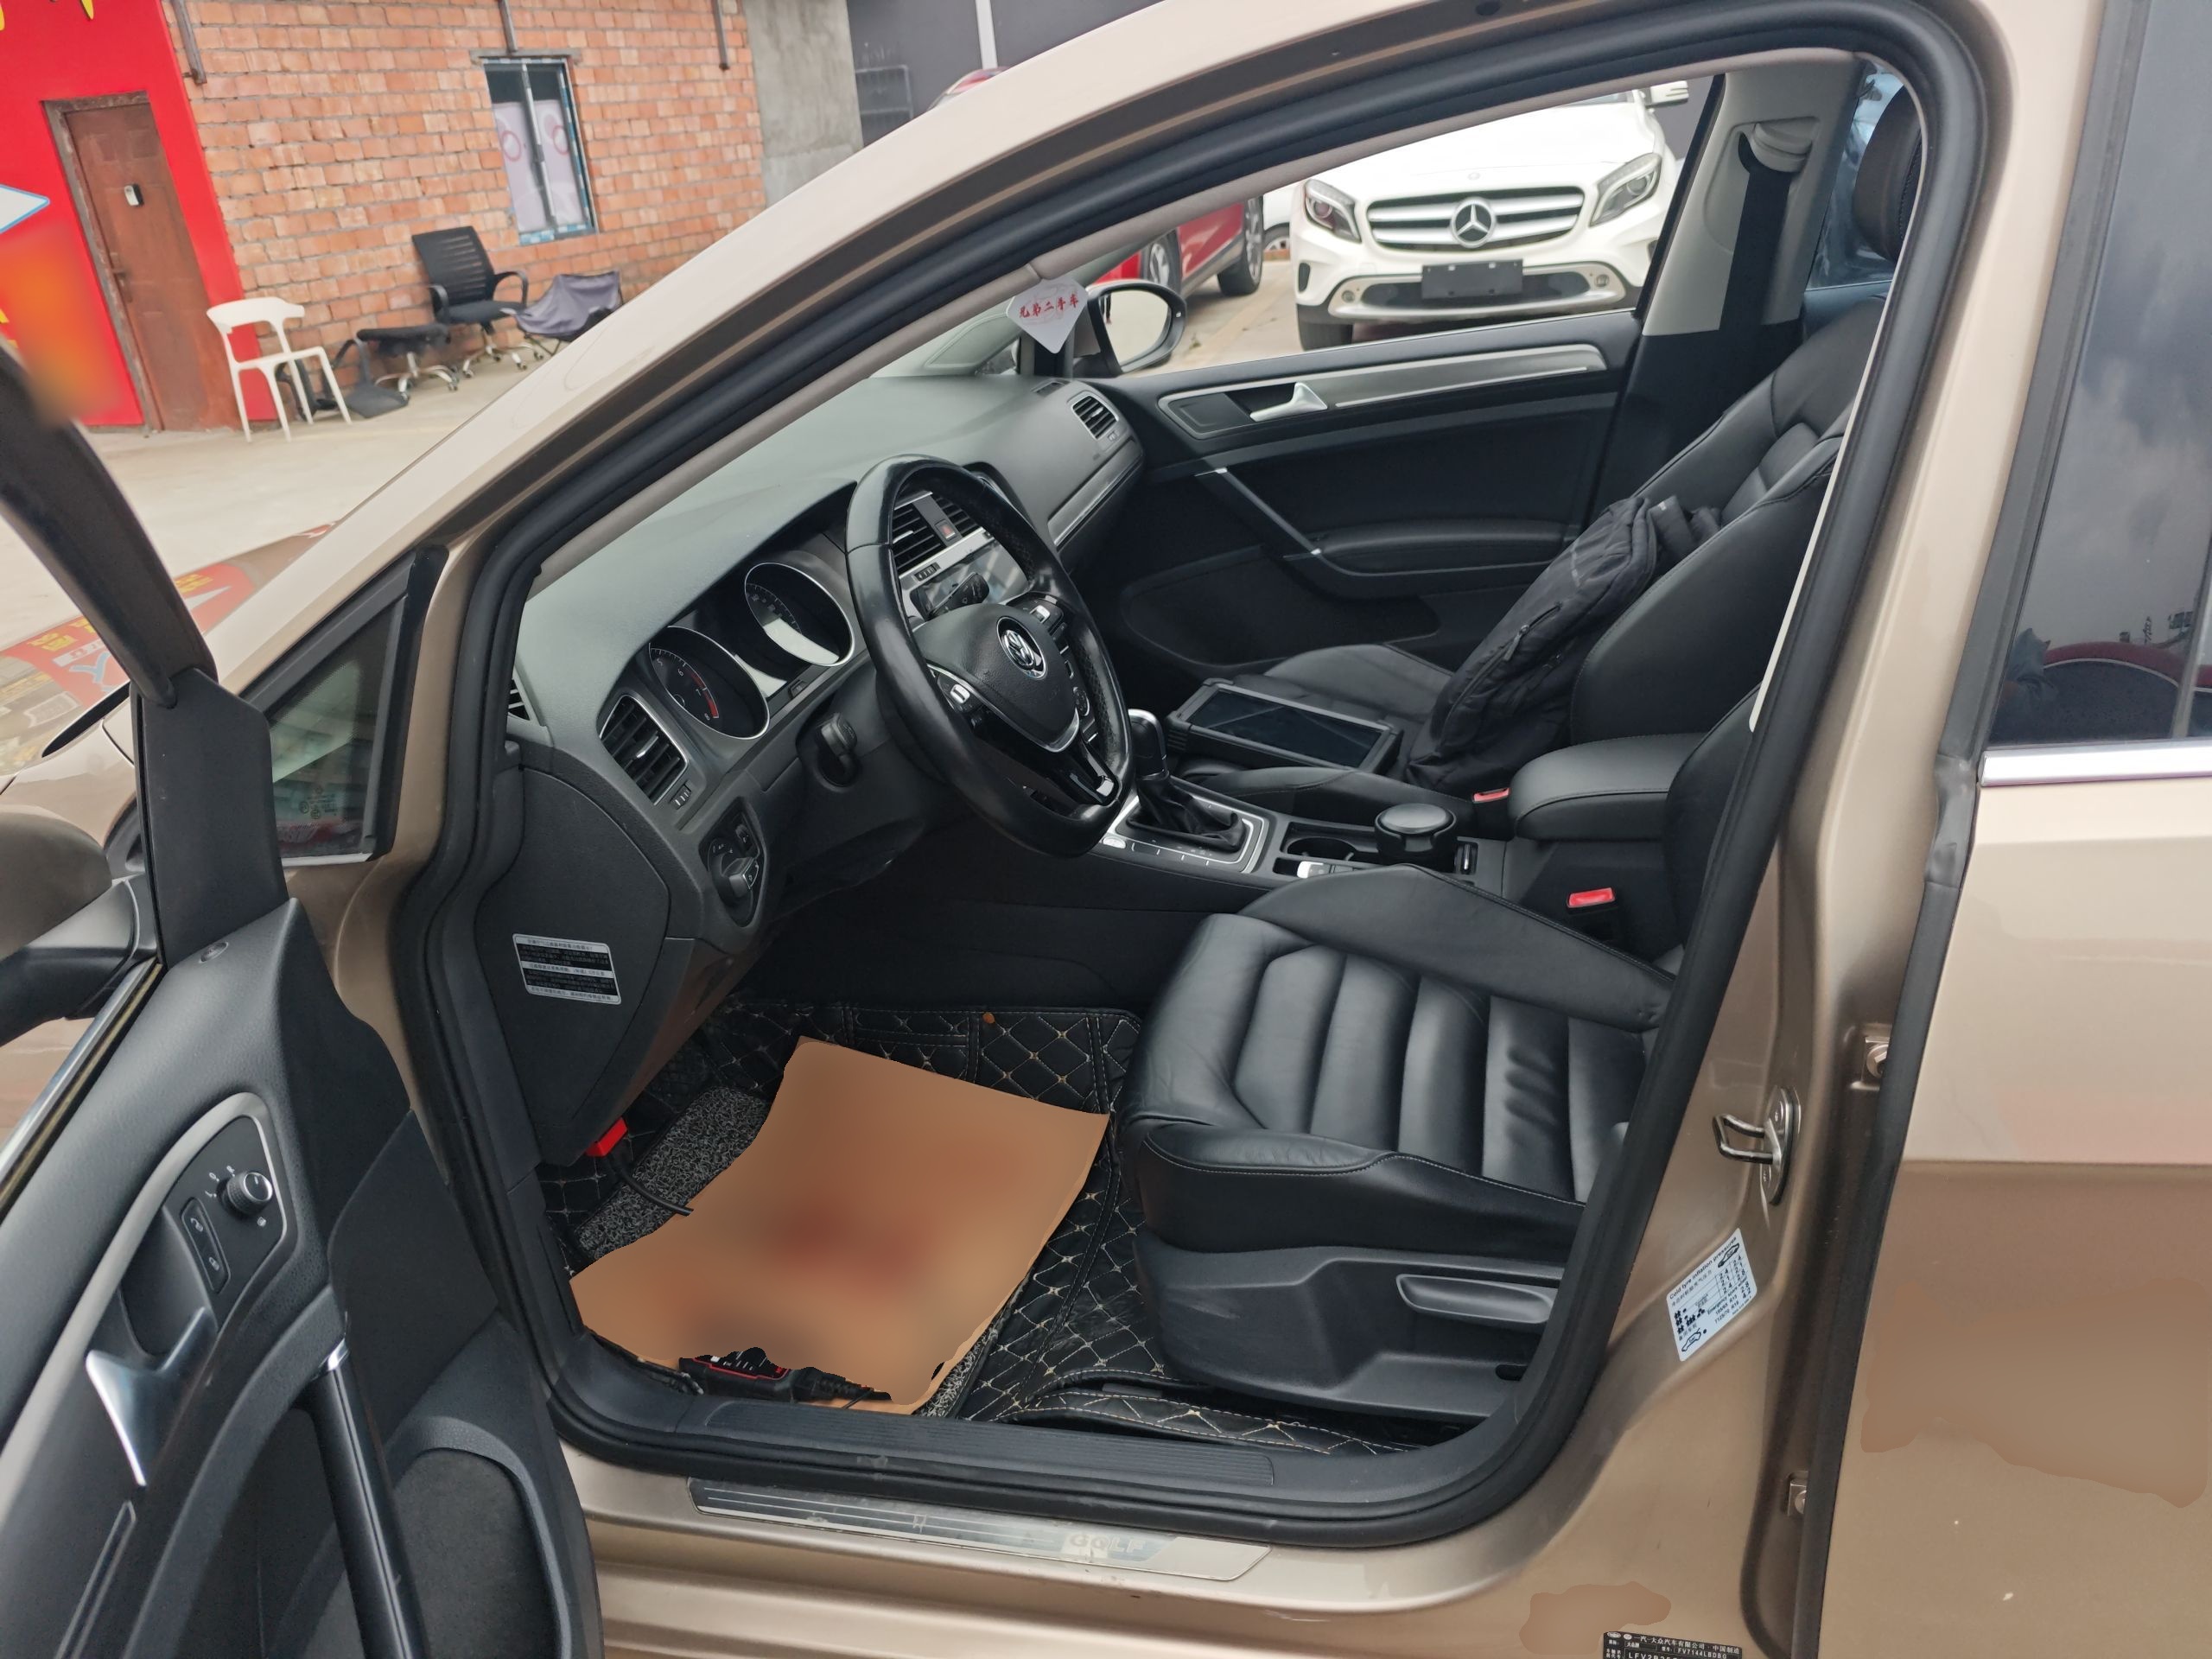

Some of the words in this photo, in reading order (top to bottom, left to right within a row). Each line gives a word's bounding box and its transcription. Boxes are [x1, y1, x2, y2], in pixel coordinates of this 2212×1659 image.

[1019, 293, 1079, 318] 兄弟二手车
[1670, 1287, 1681, 1299] Cold
[1681, 1277, 1692, 1289] tyre
[1692, 1260, 1713, 1280] inflation
[1713, 1237, 1737, 1262] pressures
[1070, 1534, 1146, 1554] GOLF
